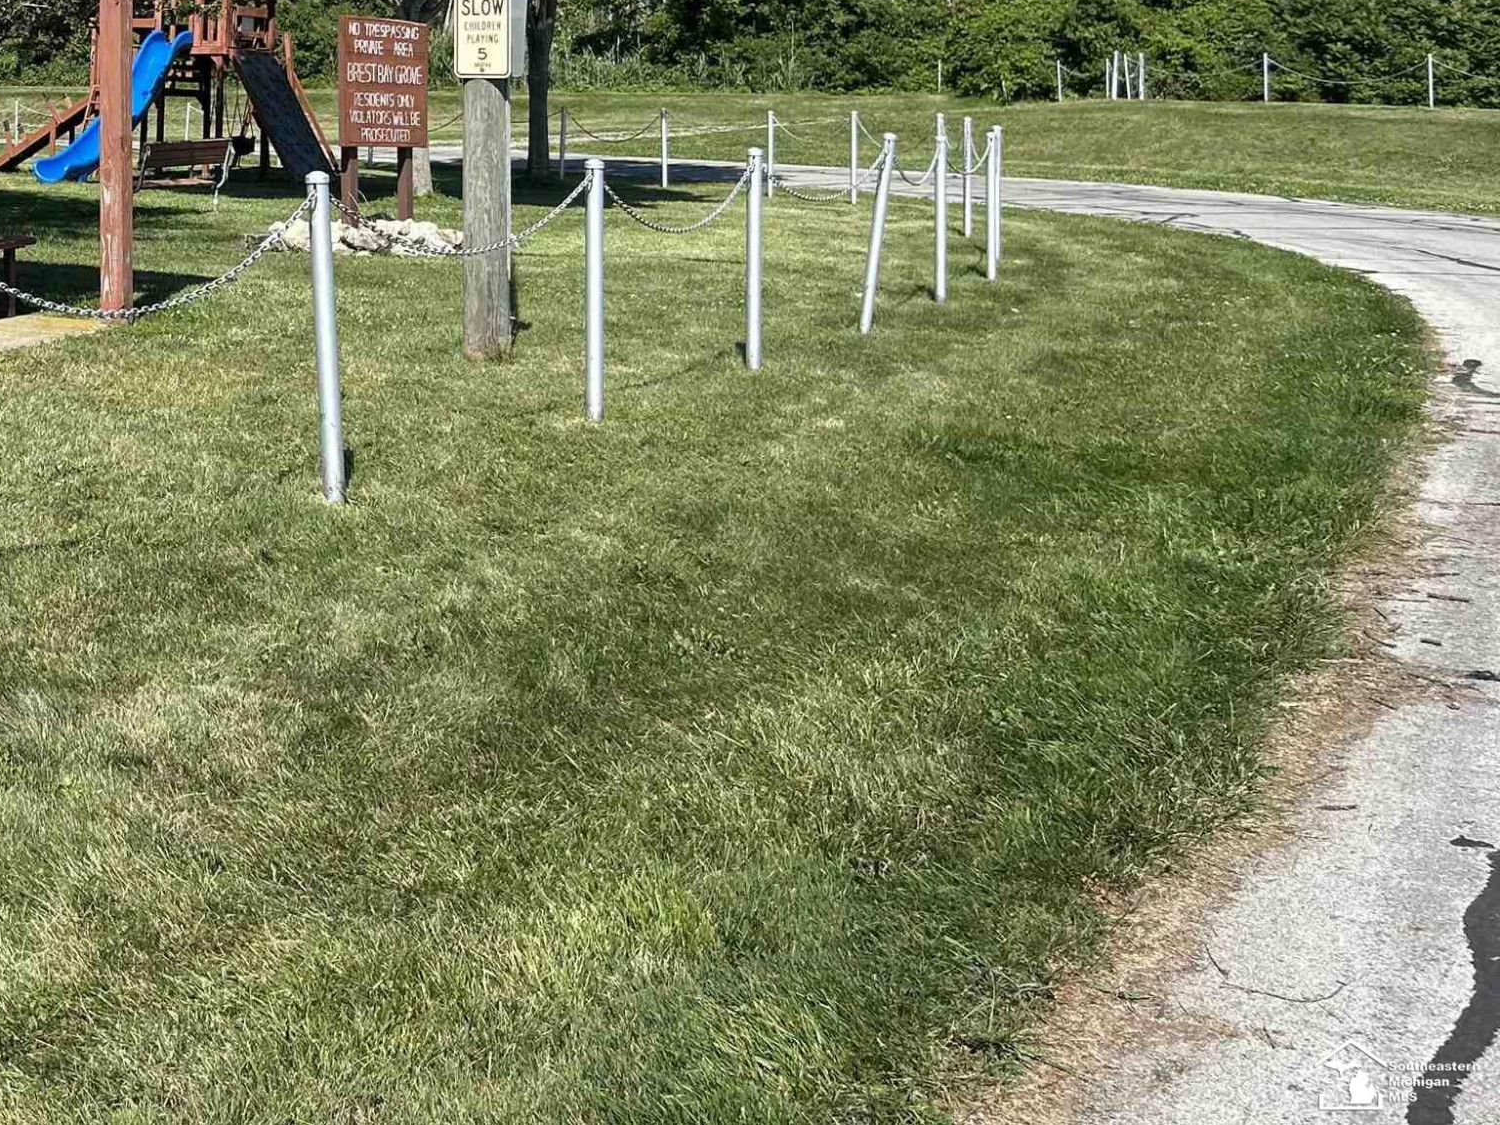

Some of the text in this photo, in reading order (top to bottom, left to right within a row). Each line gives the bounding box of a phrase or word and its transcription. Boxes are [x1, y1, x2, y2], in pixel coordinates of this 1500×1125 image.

[462, 0, 503, 15] SLOW
[349, 23, 419, 39] NO TRESPASSING
[464, 21, 501, 31] CHILDREN
[467, 34, 498, 43] PLAYING
[354, 40, 413, 57] PRIVATE AREA
[478, 48, 487, 60] 5
[348, 63, 422, 85] BREST BAY GROVE
[354, 93, 414, 107] RESIDENTS ONLY
[350, 110, 420, 125] VIOLATORS WILL BE
[361, 128, 410, 141] PROSECUTED
